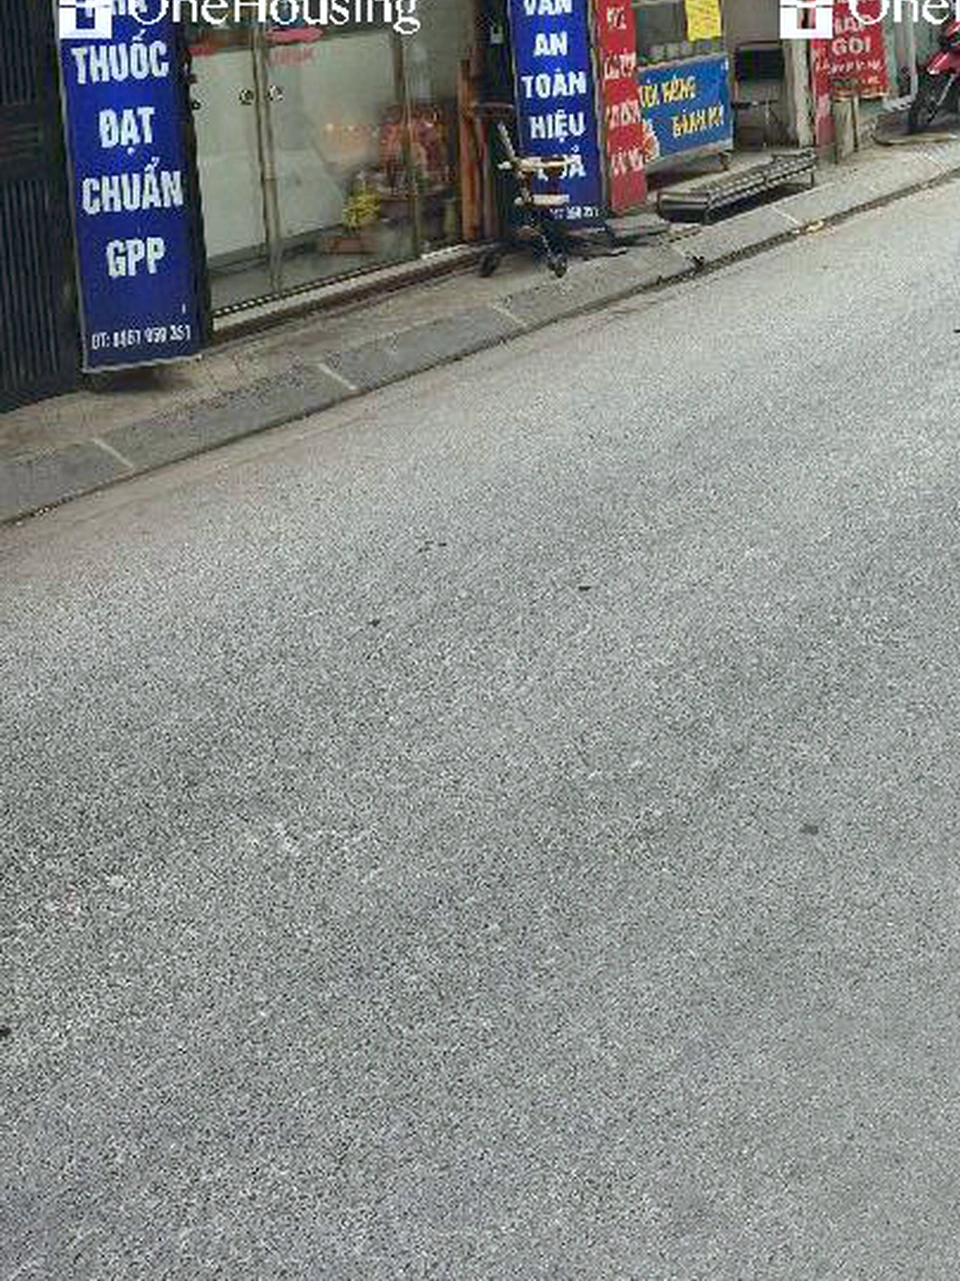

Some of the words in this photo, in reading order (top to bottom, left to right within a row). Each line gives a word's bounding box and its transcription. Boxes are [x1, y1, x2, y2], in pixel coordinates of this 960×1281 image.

[70, 28, 169, 85] THUỐC
[533, 30, 568, 57] AN
[521, 67, 588, 99] TOÀN
[99, 106, 156, 156] ĐẠT
[529, 108, 586, 143] HIỆU
[82, 156, 184, 215] CHUẨN
[106, 236, 166, 280] GPP
